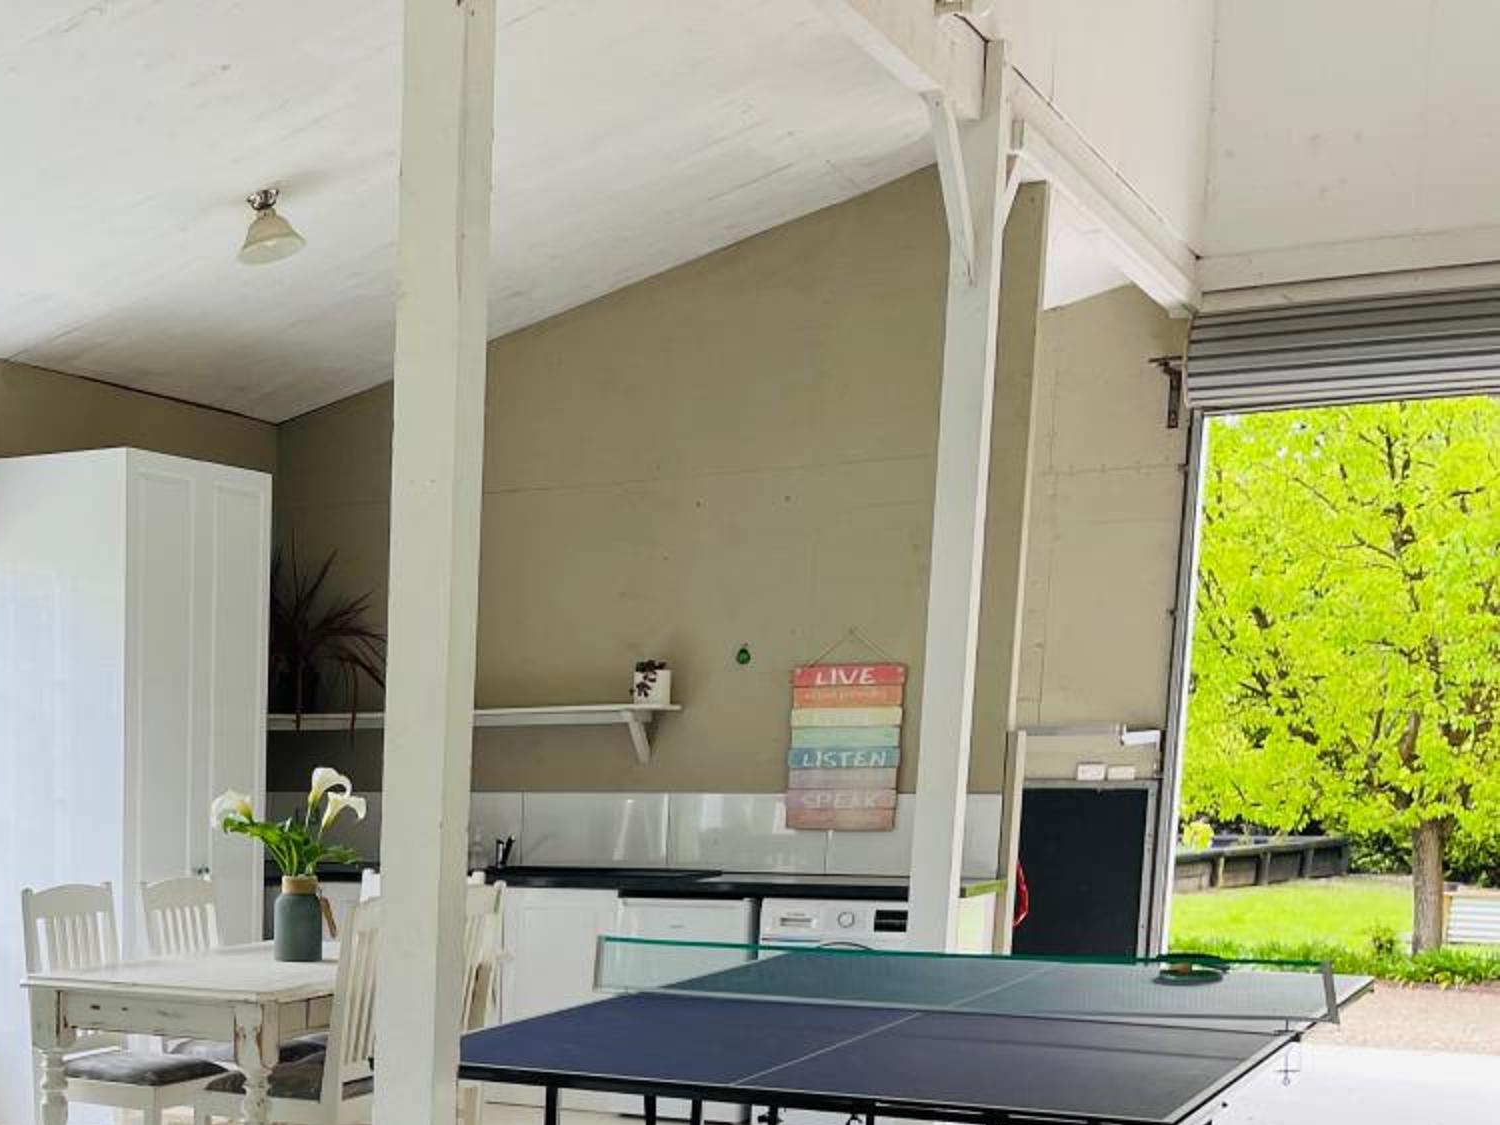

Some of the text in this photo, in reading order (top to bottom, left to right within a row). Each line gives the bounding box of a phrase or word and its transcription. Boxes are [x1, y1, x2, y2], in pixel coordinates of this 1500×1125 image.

[815, 668, 876, 685] LIVE
[803, 751, 887, 768] LISTEN
[803, 791, 880, 808] SPEAK
